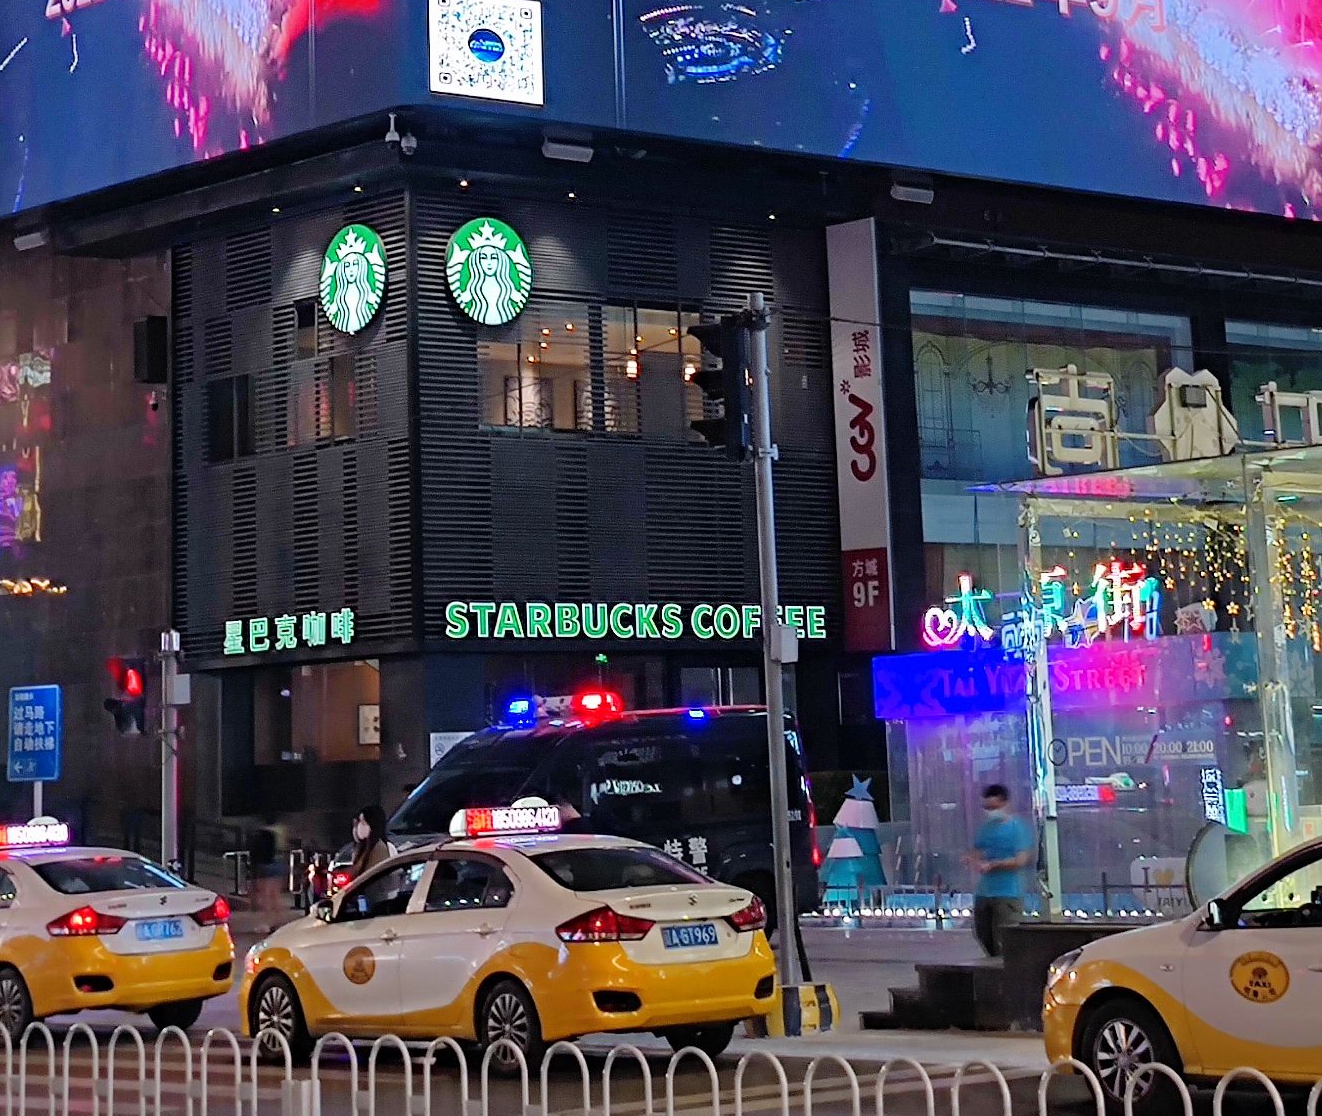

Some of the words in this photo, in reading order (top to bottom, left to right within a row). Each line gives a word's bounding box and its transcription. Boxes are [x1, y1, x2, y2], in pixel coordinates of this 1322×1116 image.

[852, 330, 872, 378] 影城
[848, 393, 877, 482] CGV
[852, 581, 879, 608] 9F
[223, 607, 355, 656] 星巴克咖啡
[445, 601, 684, 640] STARBUCKS
[13, 705, 45, 721] 过马路
[13, 720, 56, 737] 请走地下
[13, 736, 56, 752] 自动扶梯
[663, 836, 708, 865] 特警
